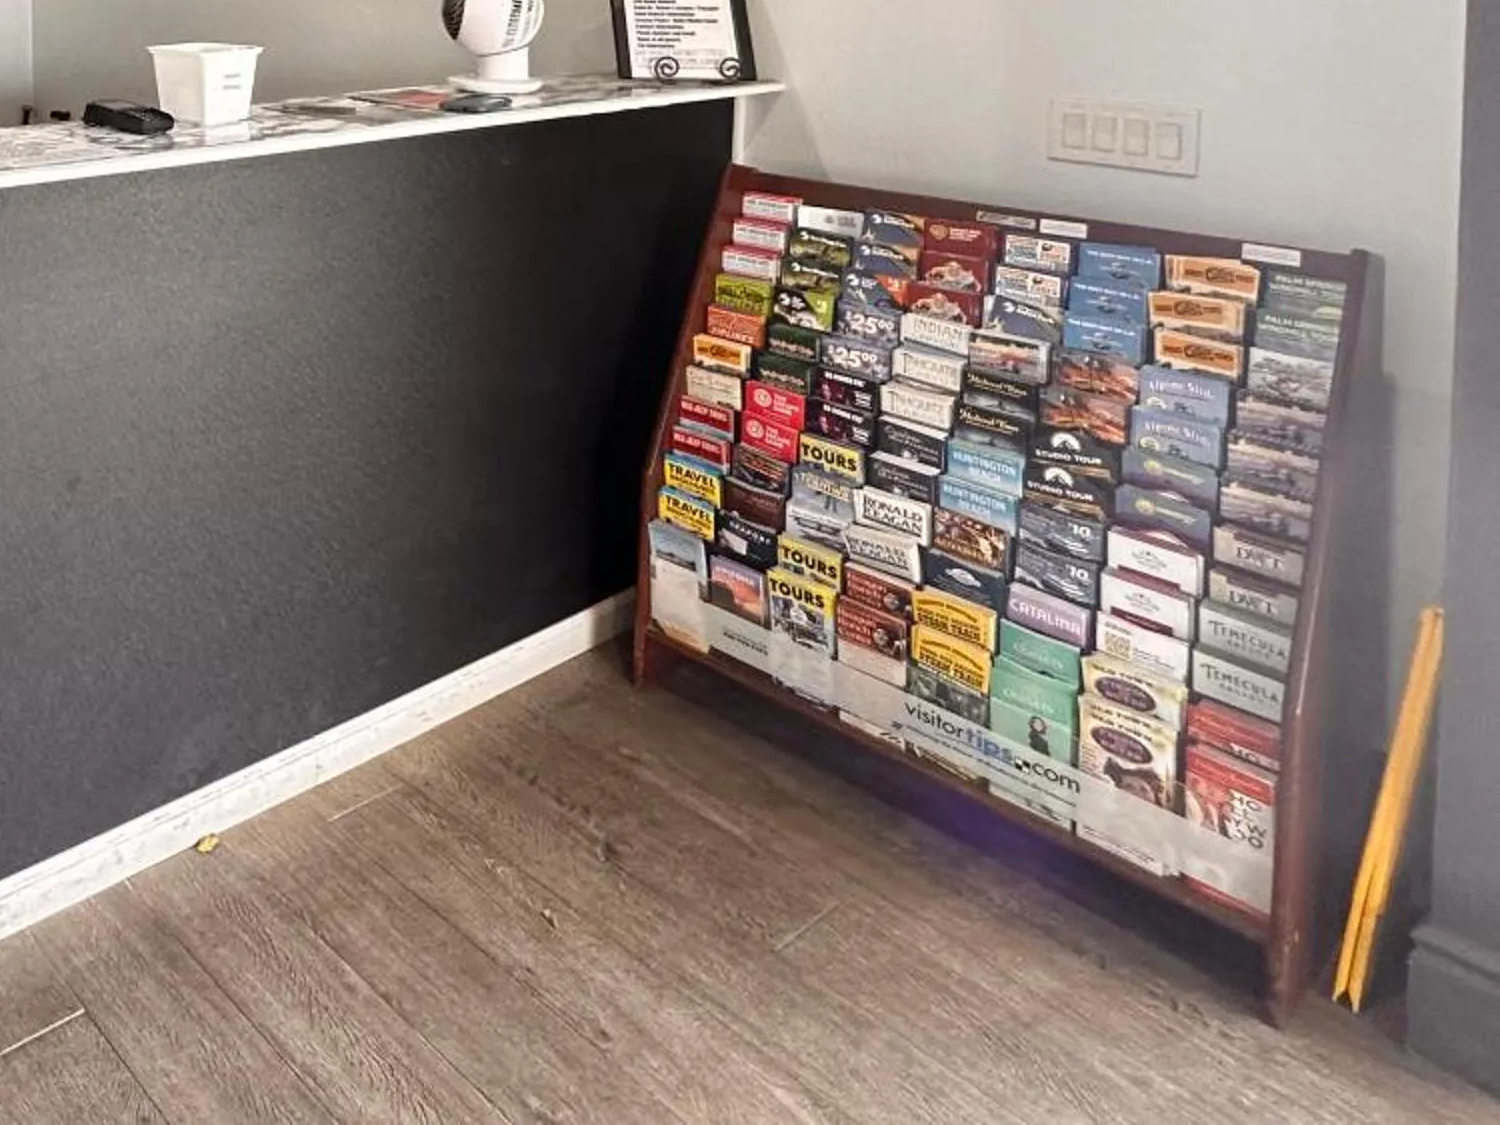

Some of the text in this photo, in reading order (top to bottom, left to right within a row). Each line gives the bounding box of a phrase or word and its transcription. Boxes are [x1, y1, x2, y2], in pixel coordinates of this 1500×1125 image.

[802, 443, 857, 473] TOURS
[669, 462, 716, 489] TRAVEL
[781, 545, 838, 579] TOURS
[769, 578, 826, 609] TOURS
[1200, 663, 1279, 702] TEMECULA
